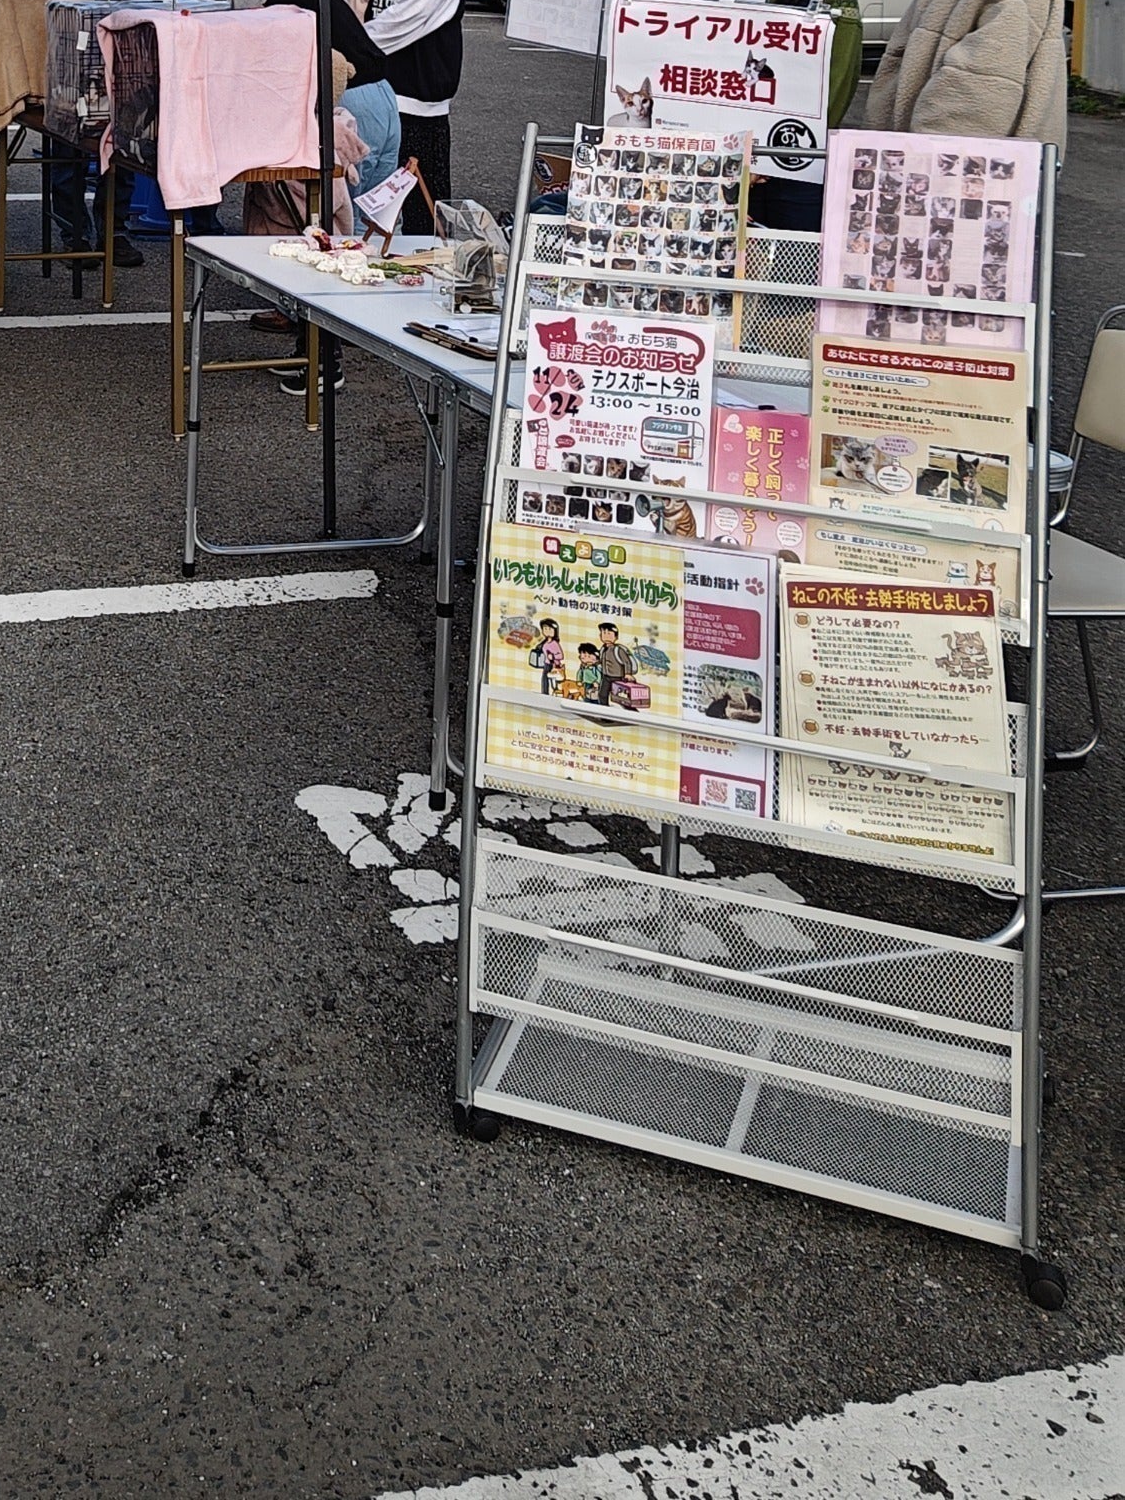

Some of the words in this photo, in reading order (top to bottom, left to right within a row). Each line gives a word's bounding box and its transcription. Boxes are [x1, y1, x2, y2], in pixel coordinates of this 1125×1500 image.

[618, 7, 822, 55] トライアル受付
[659, 63, 777, 105] 相談窓口
[614, 134, 716, 151] おもち猫保育園
[549, 342, 696, 373] 譲渡会のお知らせ
[591, 369, 701, 401] テクスポート今治
[589, 395, 633, 410] 13:00
[657, 403, 702, 418] 15:00
[493, 557, 678, 609] いつもいっしょにいたいから
[684, 572, 740, 592] 活動指針
[534, 594, 633, 618] ペット動物の災害対策
[792, 586, 989, 613] ねこの不妊・去勢手術をしましょう
[816, 616, 900, 629] どうして必要なの?
[820, 674, 993, 694] 子ねこが生まれない以外になにかあるの?
